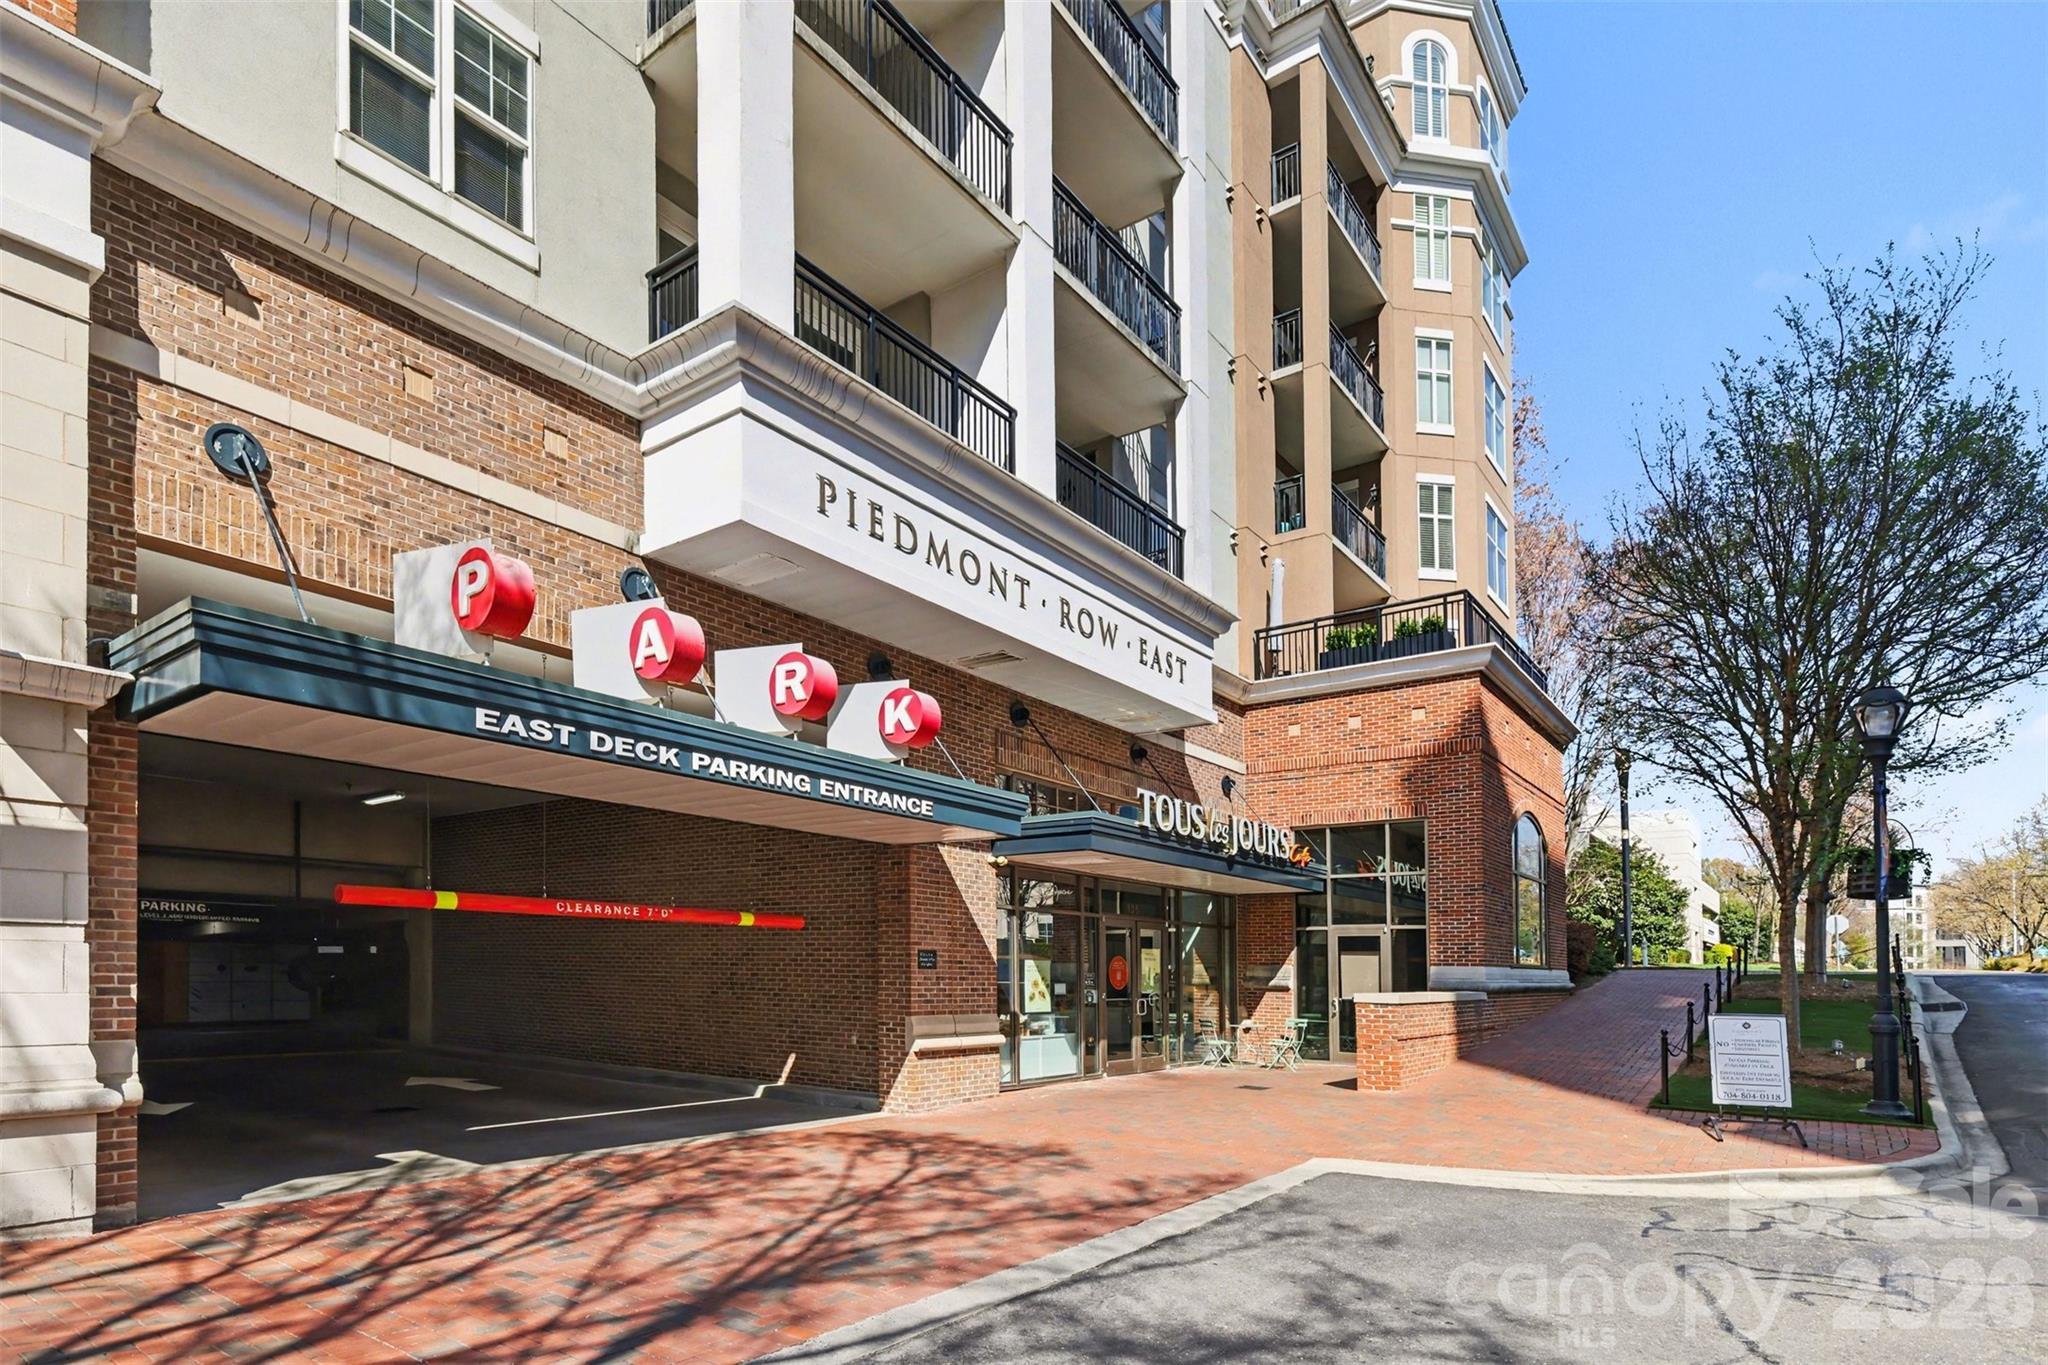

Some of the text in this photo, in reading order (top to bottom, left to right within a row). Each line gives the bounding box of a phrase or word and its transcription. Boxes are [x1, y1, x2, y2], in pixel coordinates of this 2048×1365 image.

[816, 472, 1187, 685] PIEDMONT ROW EAST
[474, 706, 934, 816] EAST DECK PARKING ENTRANCE
[1135, 787, 1290, 859] TOUS les JOURS
[140, 900, 207, 913] PARKING
[556, 902, 640, 917] CLEARANCE
